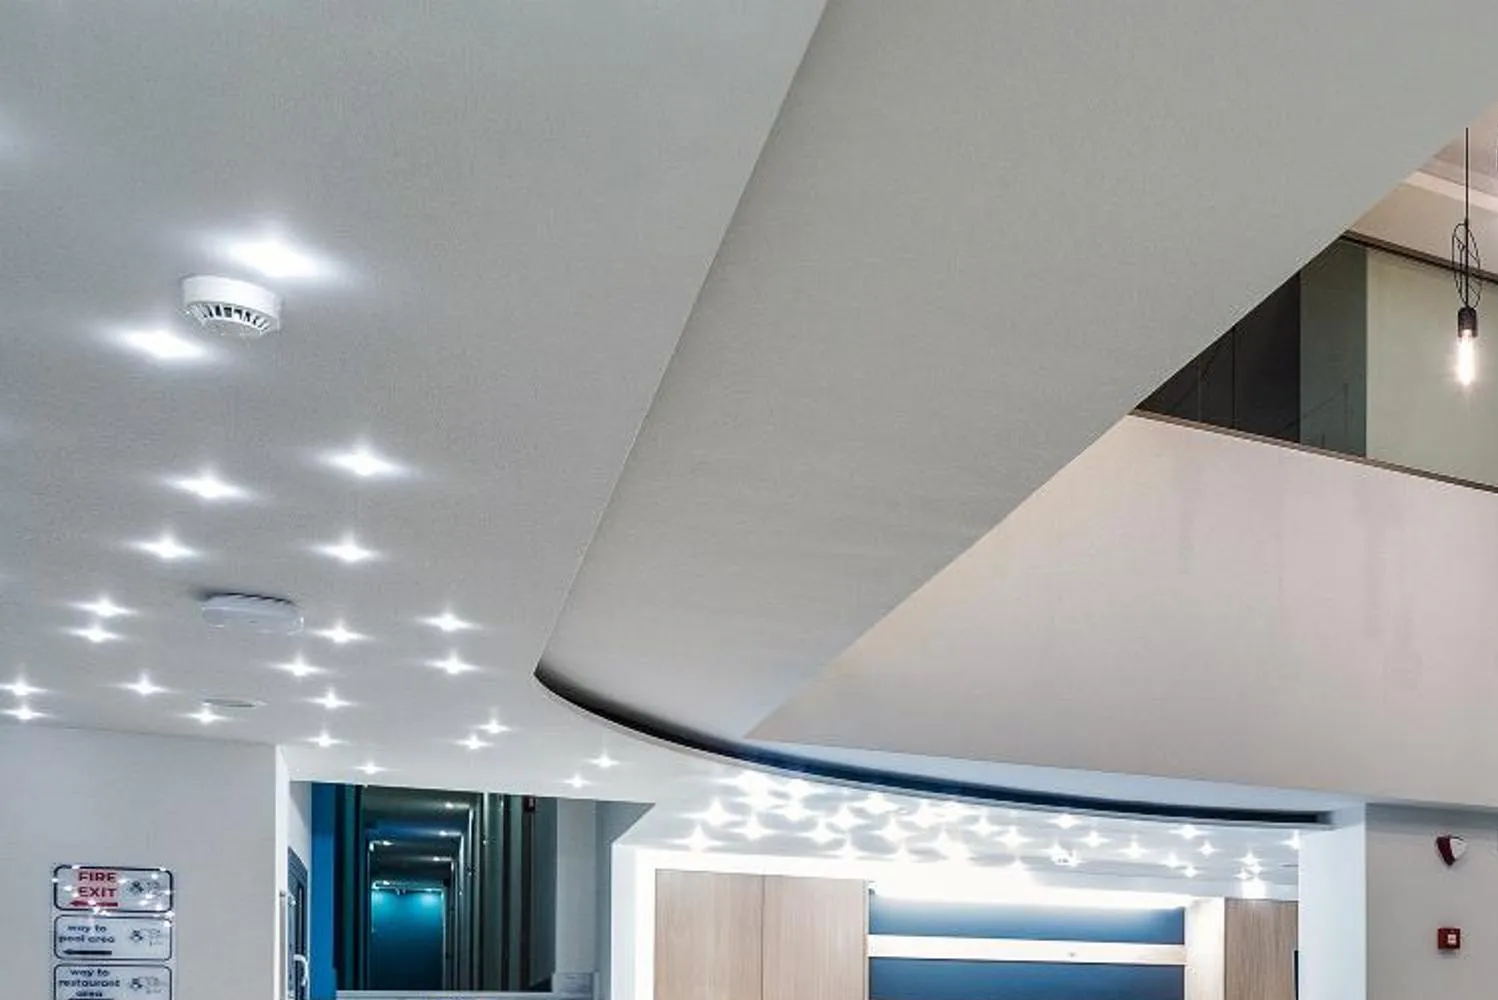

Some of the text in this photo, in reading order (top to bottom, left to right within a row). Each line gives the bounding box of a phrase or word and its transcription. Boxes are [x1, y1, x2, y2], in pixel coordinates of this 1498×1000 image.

[78, 871, 117, 882] FIRE
[78, 886, 117, 898] EXIT
[67, 923, 107, 933] way to
[58, 934, 115, 944] pool area
[70, 967, 110, 977] way to
[58, 978, 121, 988] restaurant
[74, 989, 103, 998] area
